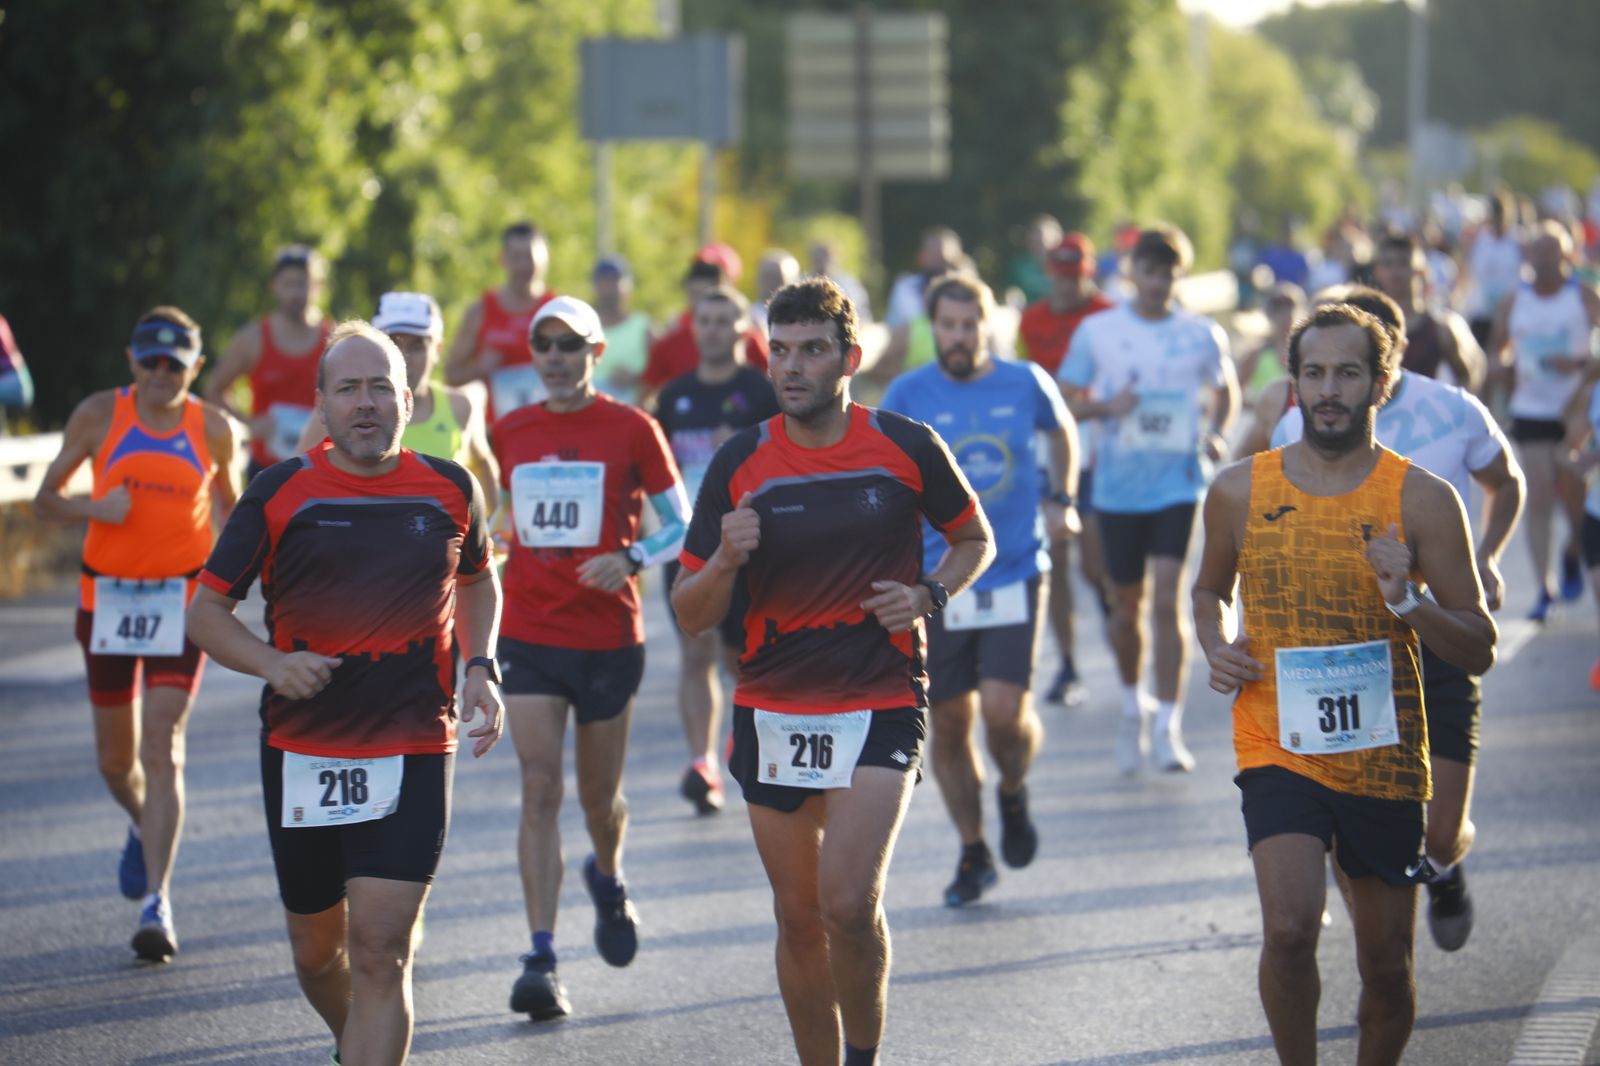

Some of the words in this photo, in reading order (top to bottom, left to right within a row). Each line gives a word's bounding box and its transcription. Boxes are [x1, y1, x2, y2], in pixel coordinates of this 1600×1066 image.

[532, 502, 579, 530] 440
[1282, 667, 1323, 680] MEDIA
[1318, 694, 1360, 733] 311
[790, 733, 833, 770] 216
[319, 768, 368, 807] 218
